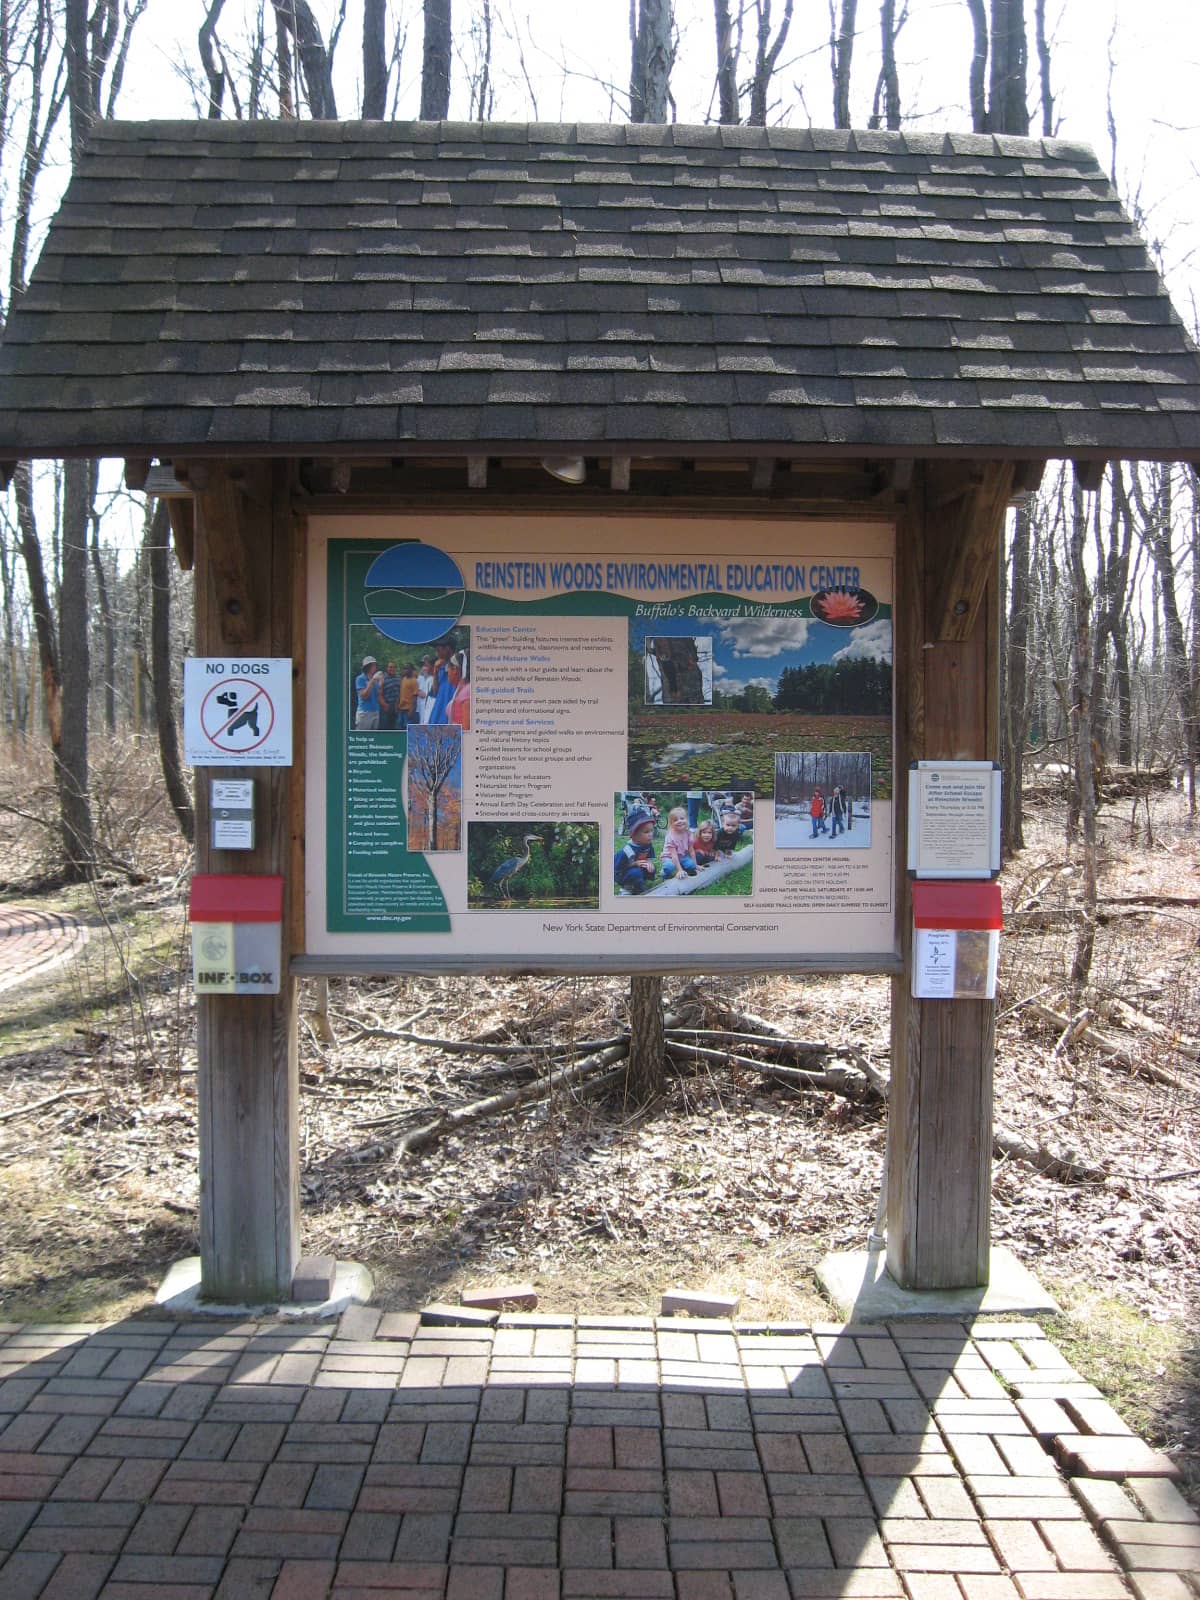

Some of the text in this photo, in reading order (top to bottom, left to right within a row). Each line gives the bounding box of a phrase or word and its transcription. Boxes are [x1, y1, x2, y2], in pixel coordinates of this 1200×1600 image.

[475, 561, 860, 591] REINSTEIN WOODS ENVIRONMENTAL EDUCATION CENTER
[635, 602, 803, 619] Buffalo's Backyard Wilderness
[512, 635, 534, 643] building
[536, 635, 558, 643] features
[206, 663, 270, 674] NO DOGS
[476, 687, 534, 695] Self-guided Trails
[506, 707, 516, 715] and
[518, 707, 555, 715] informational
[542, 923, 779, 932] New York State Department of Environmental Conservation
